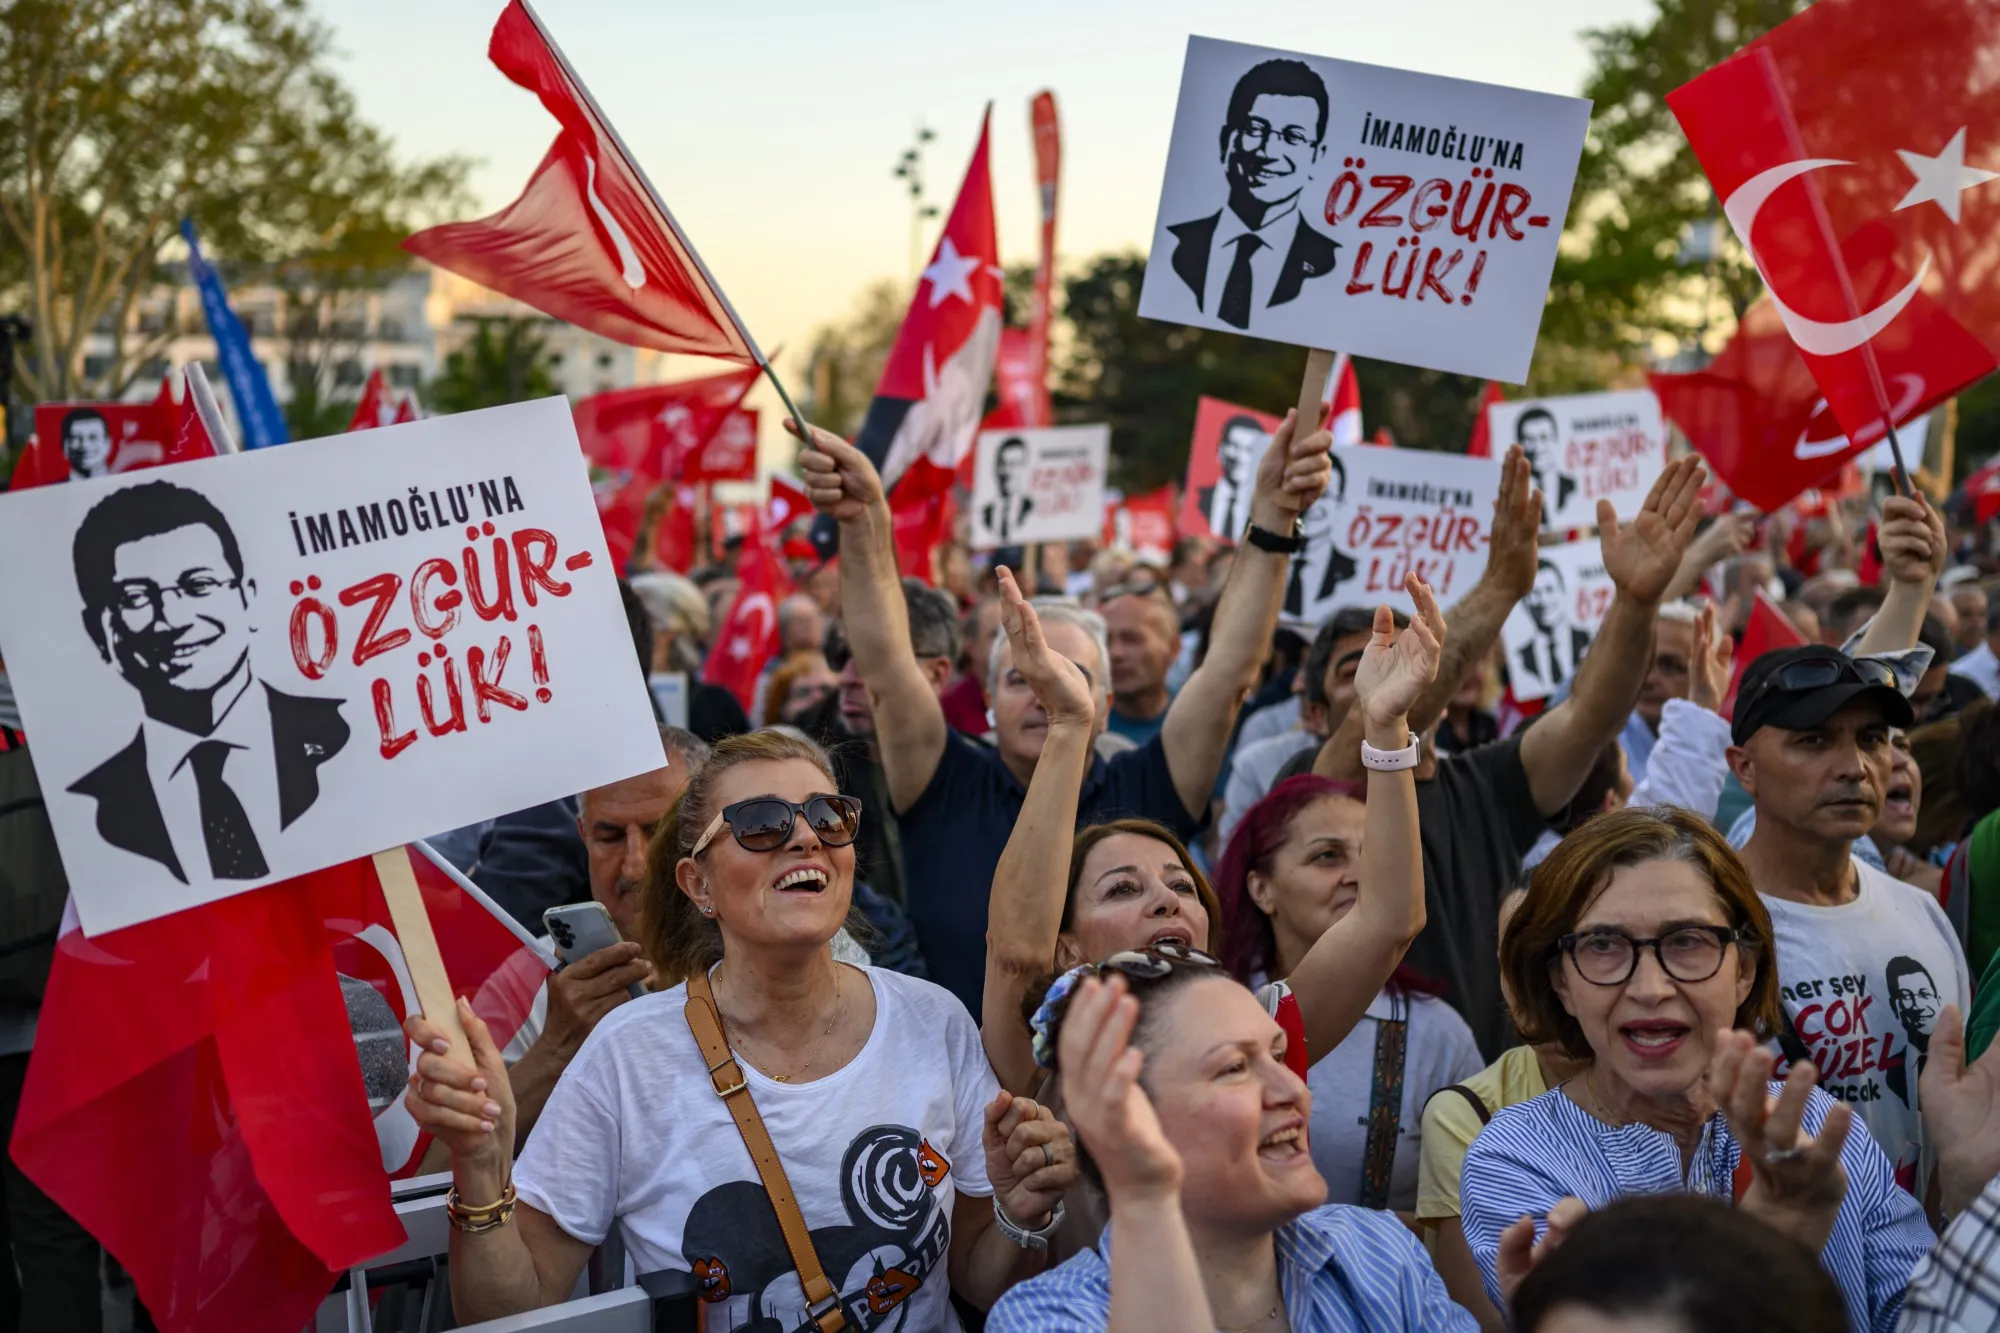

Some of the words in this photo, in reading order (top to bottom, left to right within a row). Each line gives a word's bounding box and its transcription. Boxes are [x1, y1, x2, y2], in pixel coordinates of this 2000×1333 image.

[1324, 157, 1551, 243] ÖZGÜR-
[1345, 236, 1487, 306] LÜK!
[1347, 505, 1490, 554] ÖZGÜR-
[289, 521, 593, 681] ÖZGÜR-
[371, 625, 552, 760] LÜK!
[1829, 974, 1866, 997] şey
